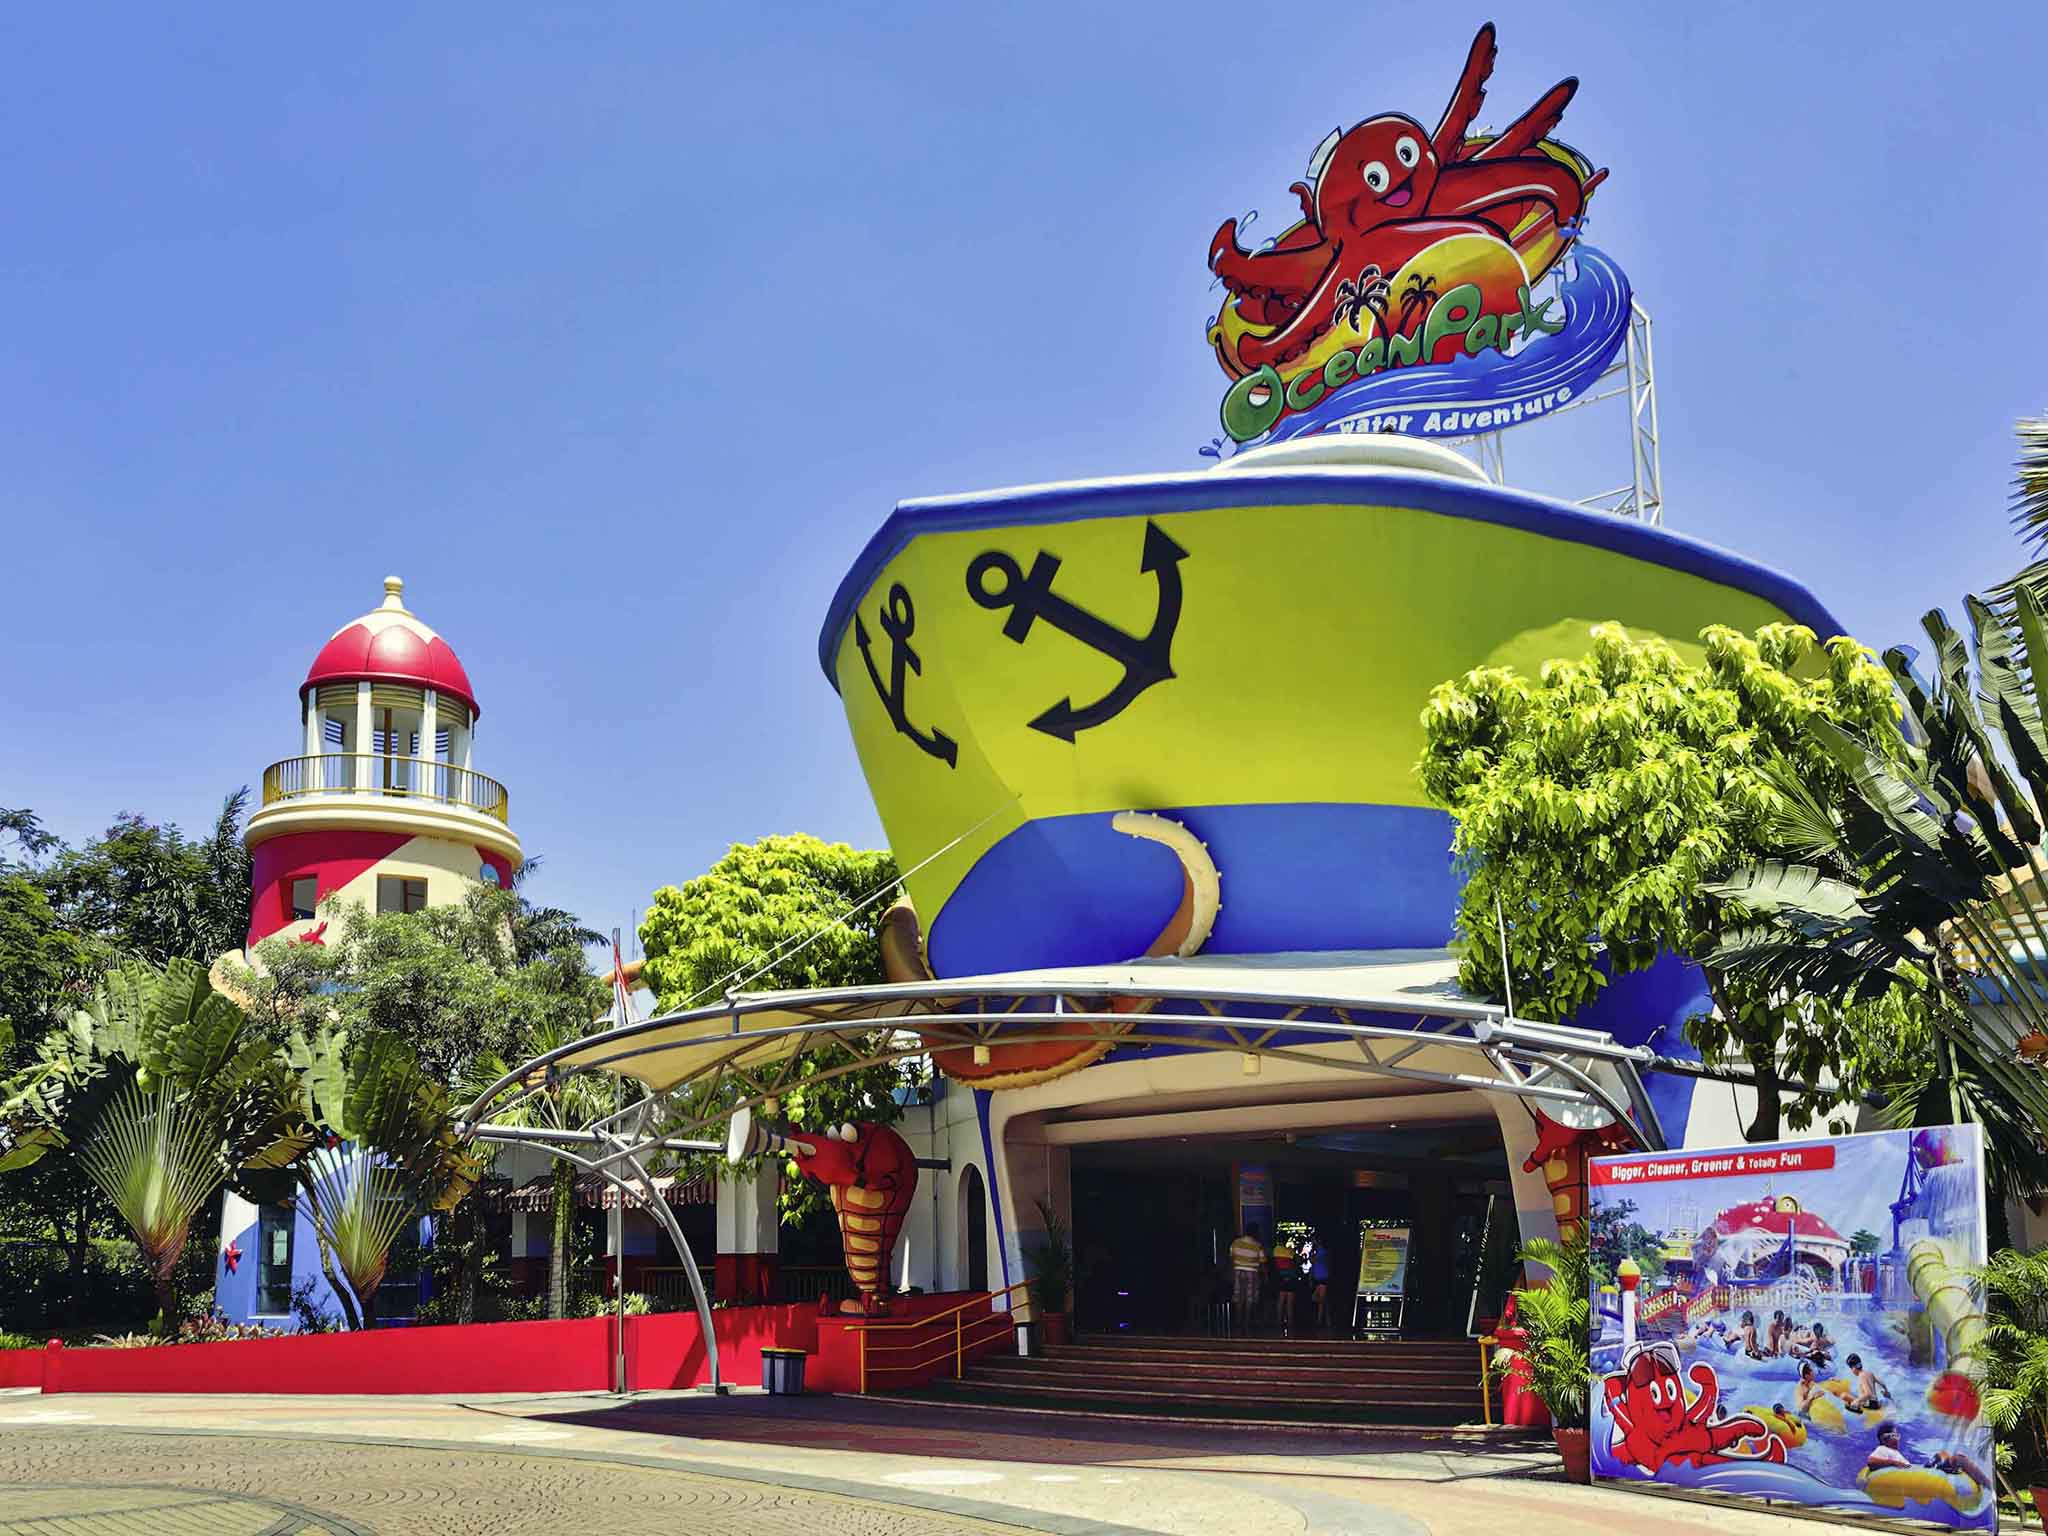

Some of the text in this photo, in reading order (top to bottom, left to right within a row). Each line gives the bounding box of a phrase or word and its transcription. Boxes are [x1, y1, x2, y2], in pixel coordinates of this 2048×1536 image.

[1423, 386, 1573, 433] Adventure
[1611, 1151, 1802, 1181] Bigger, Cleaner, Greener & Totally Fun
